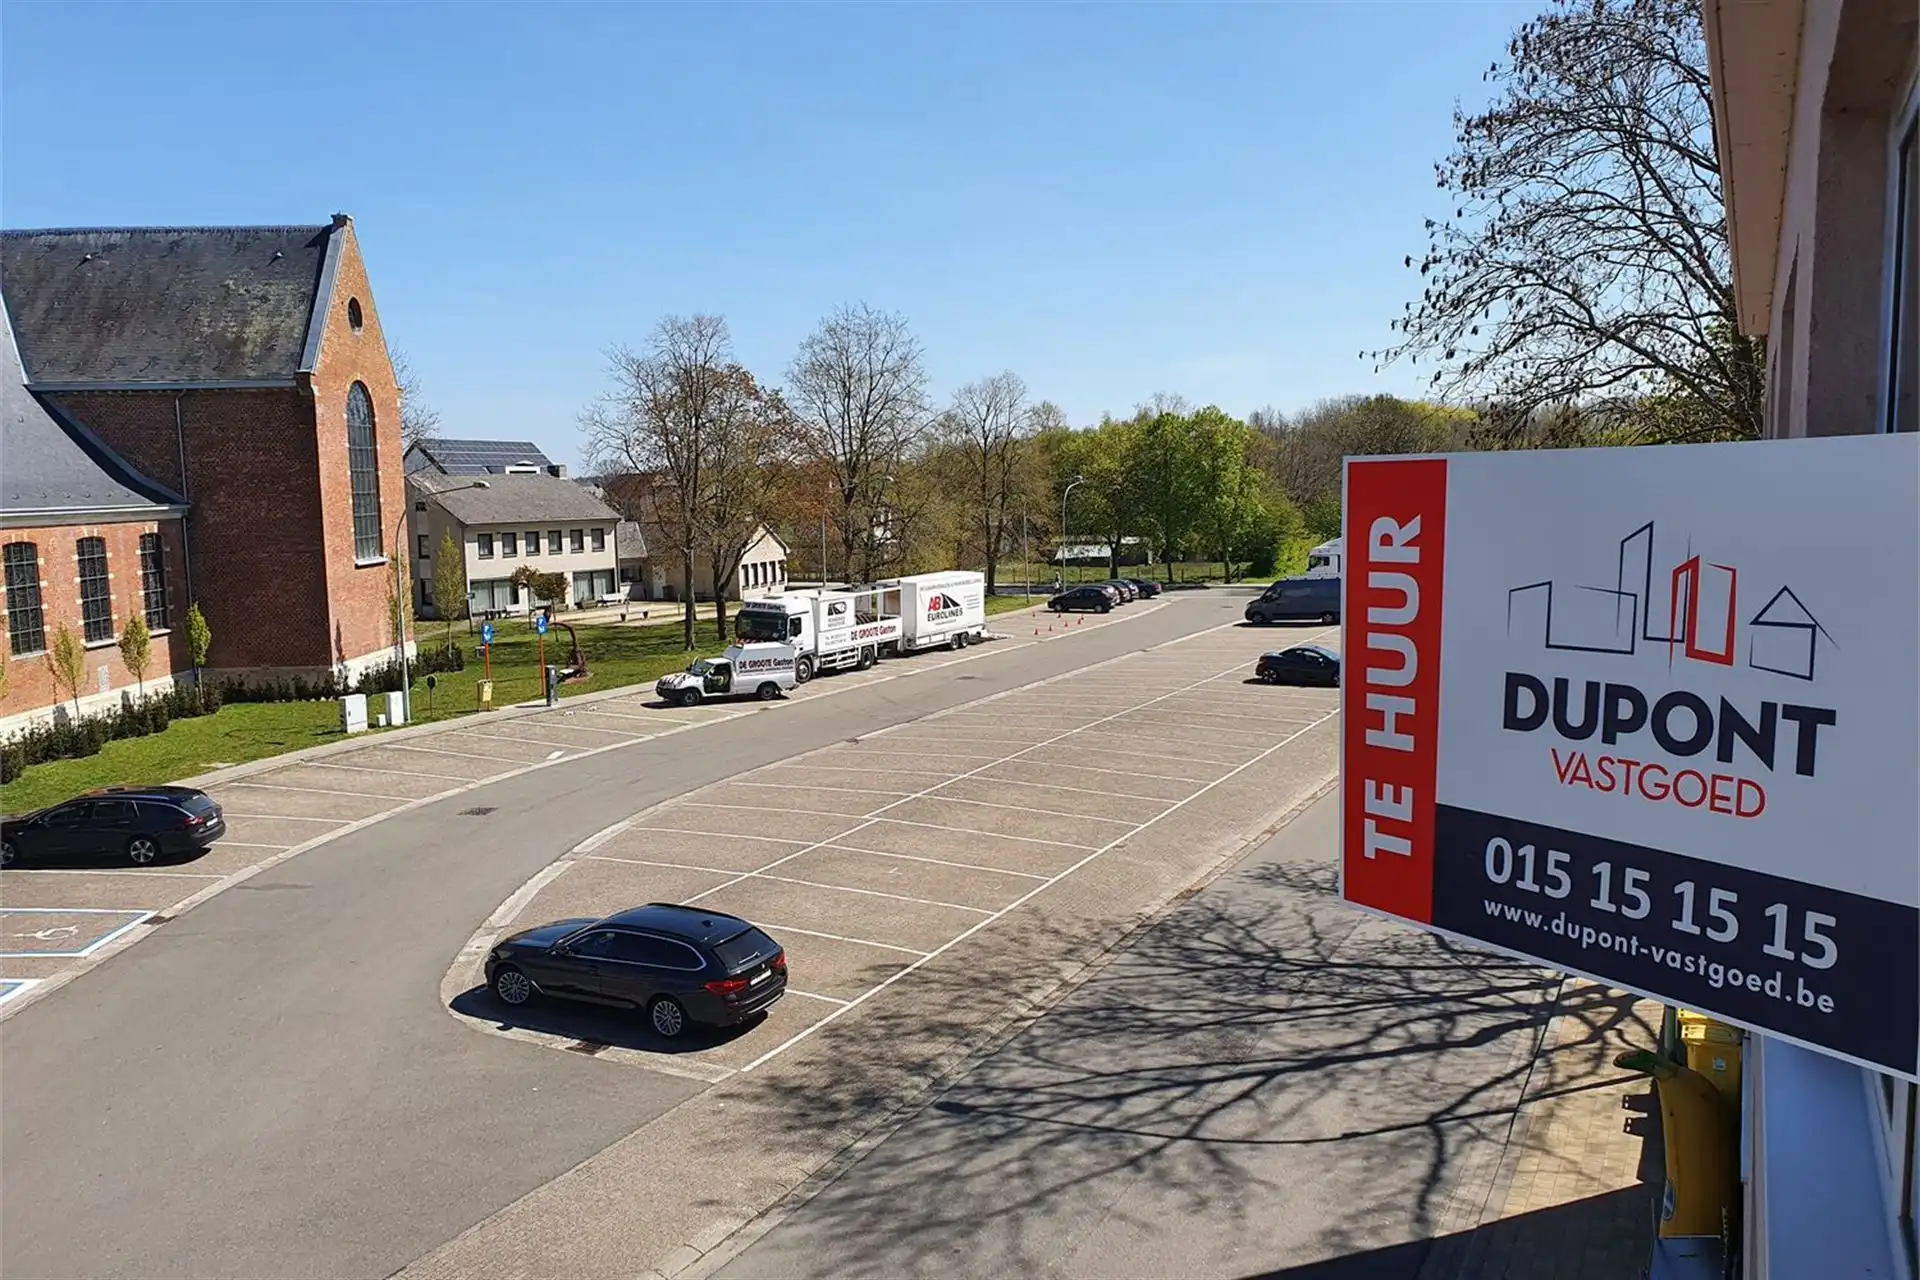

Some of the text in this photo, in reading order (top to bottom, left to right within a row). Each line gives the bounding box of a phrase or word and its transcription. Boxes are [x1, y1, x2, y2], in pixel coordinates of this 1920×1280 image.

[851, 630, 858, 640] DE
[859, 626, 879, 639] GROOTE
[928, 596, 941, 611] AB
[928, 608, 963, 622] EUROLINES
[739, 658, 794, 669] DE GROOTE Gaston
[1364, 514, 1422, 860] TE HUUR
[1502, 671, 1837, 777] DUPONT
[1550, 747, 1766, 818] VASTGOED
[1485, 836, 1838, 969] 015 15 15 15
[1483, 899, 1835, 1014] www.dupont-vastgoed.be
